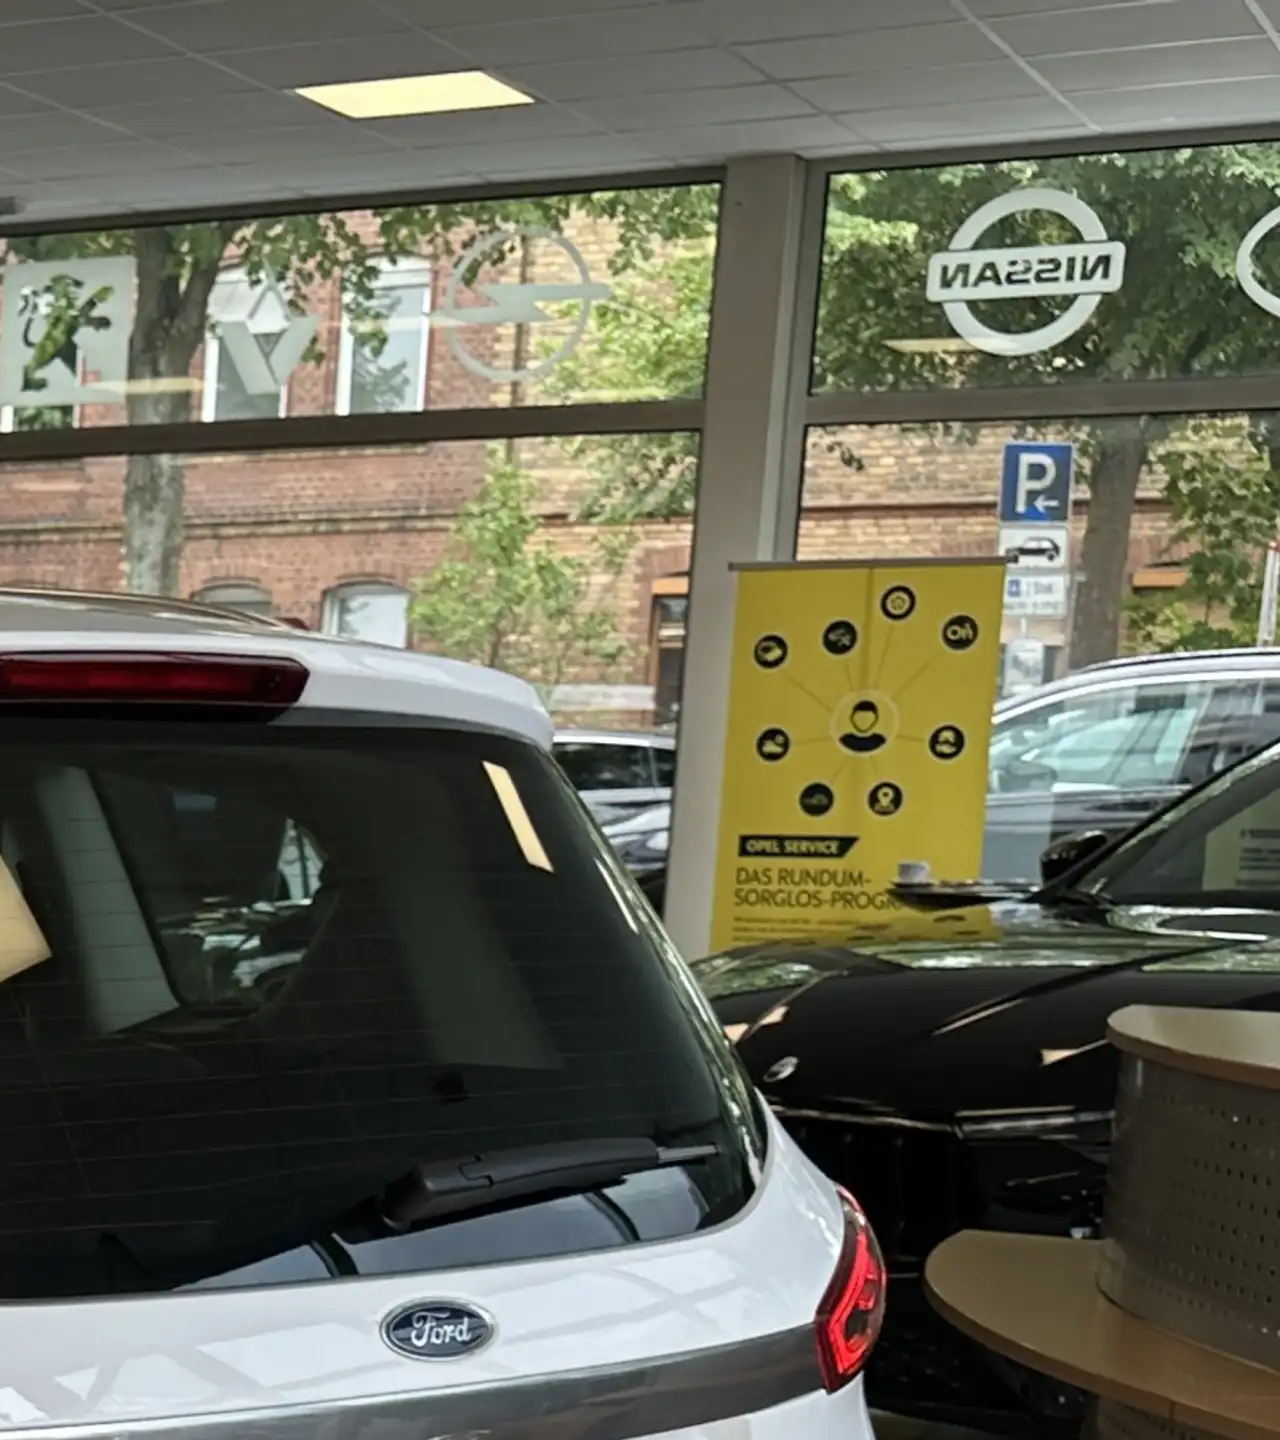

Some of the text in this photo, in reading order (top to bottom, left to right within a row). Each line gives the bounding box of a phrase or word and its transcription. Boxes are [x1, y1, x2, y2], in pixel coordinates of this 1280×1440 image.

[1015, 452, 1057, 514] P
[736, 867, 871, 888] DAS RUNDUM-
[411, 1311, 472, 1347] Ford
